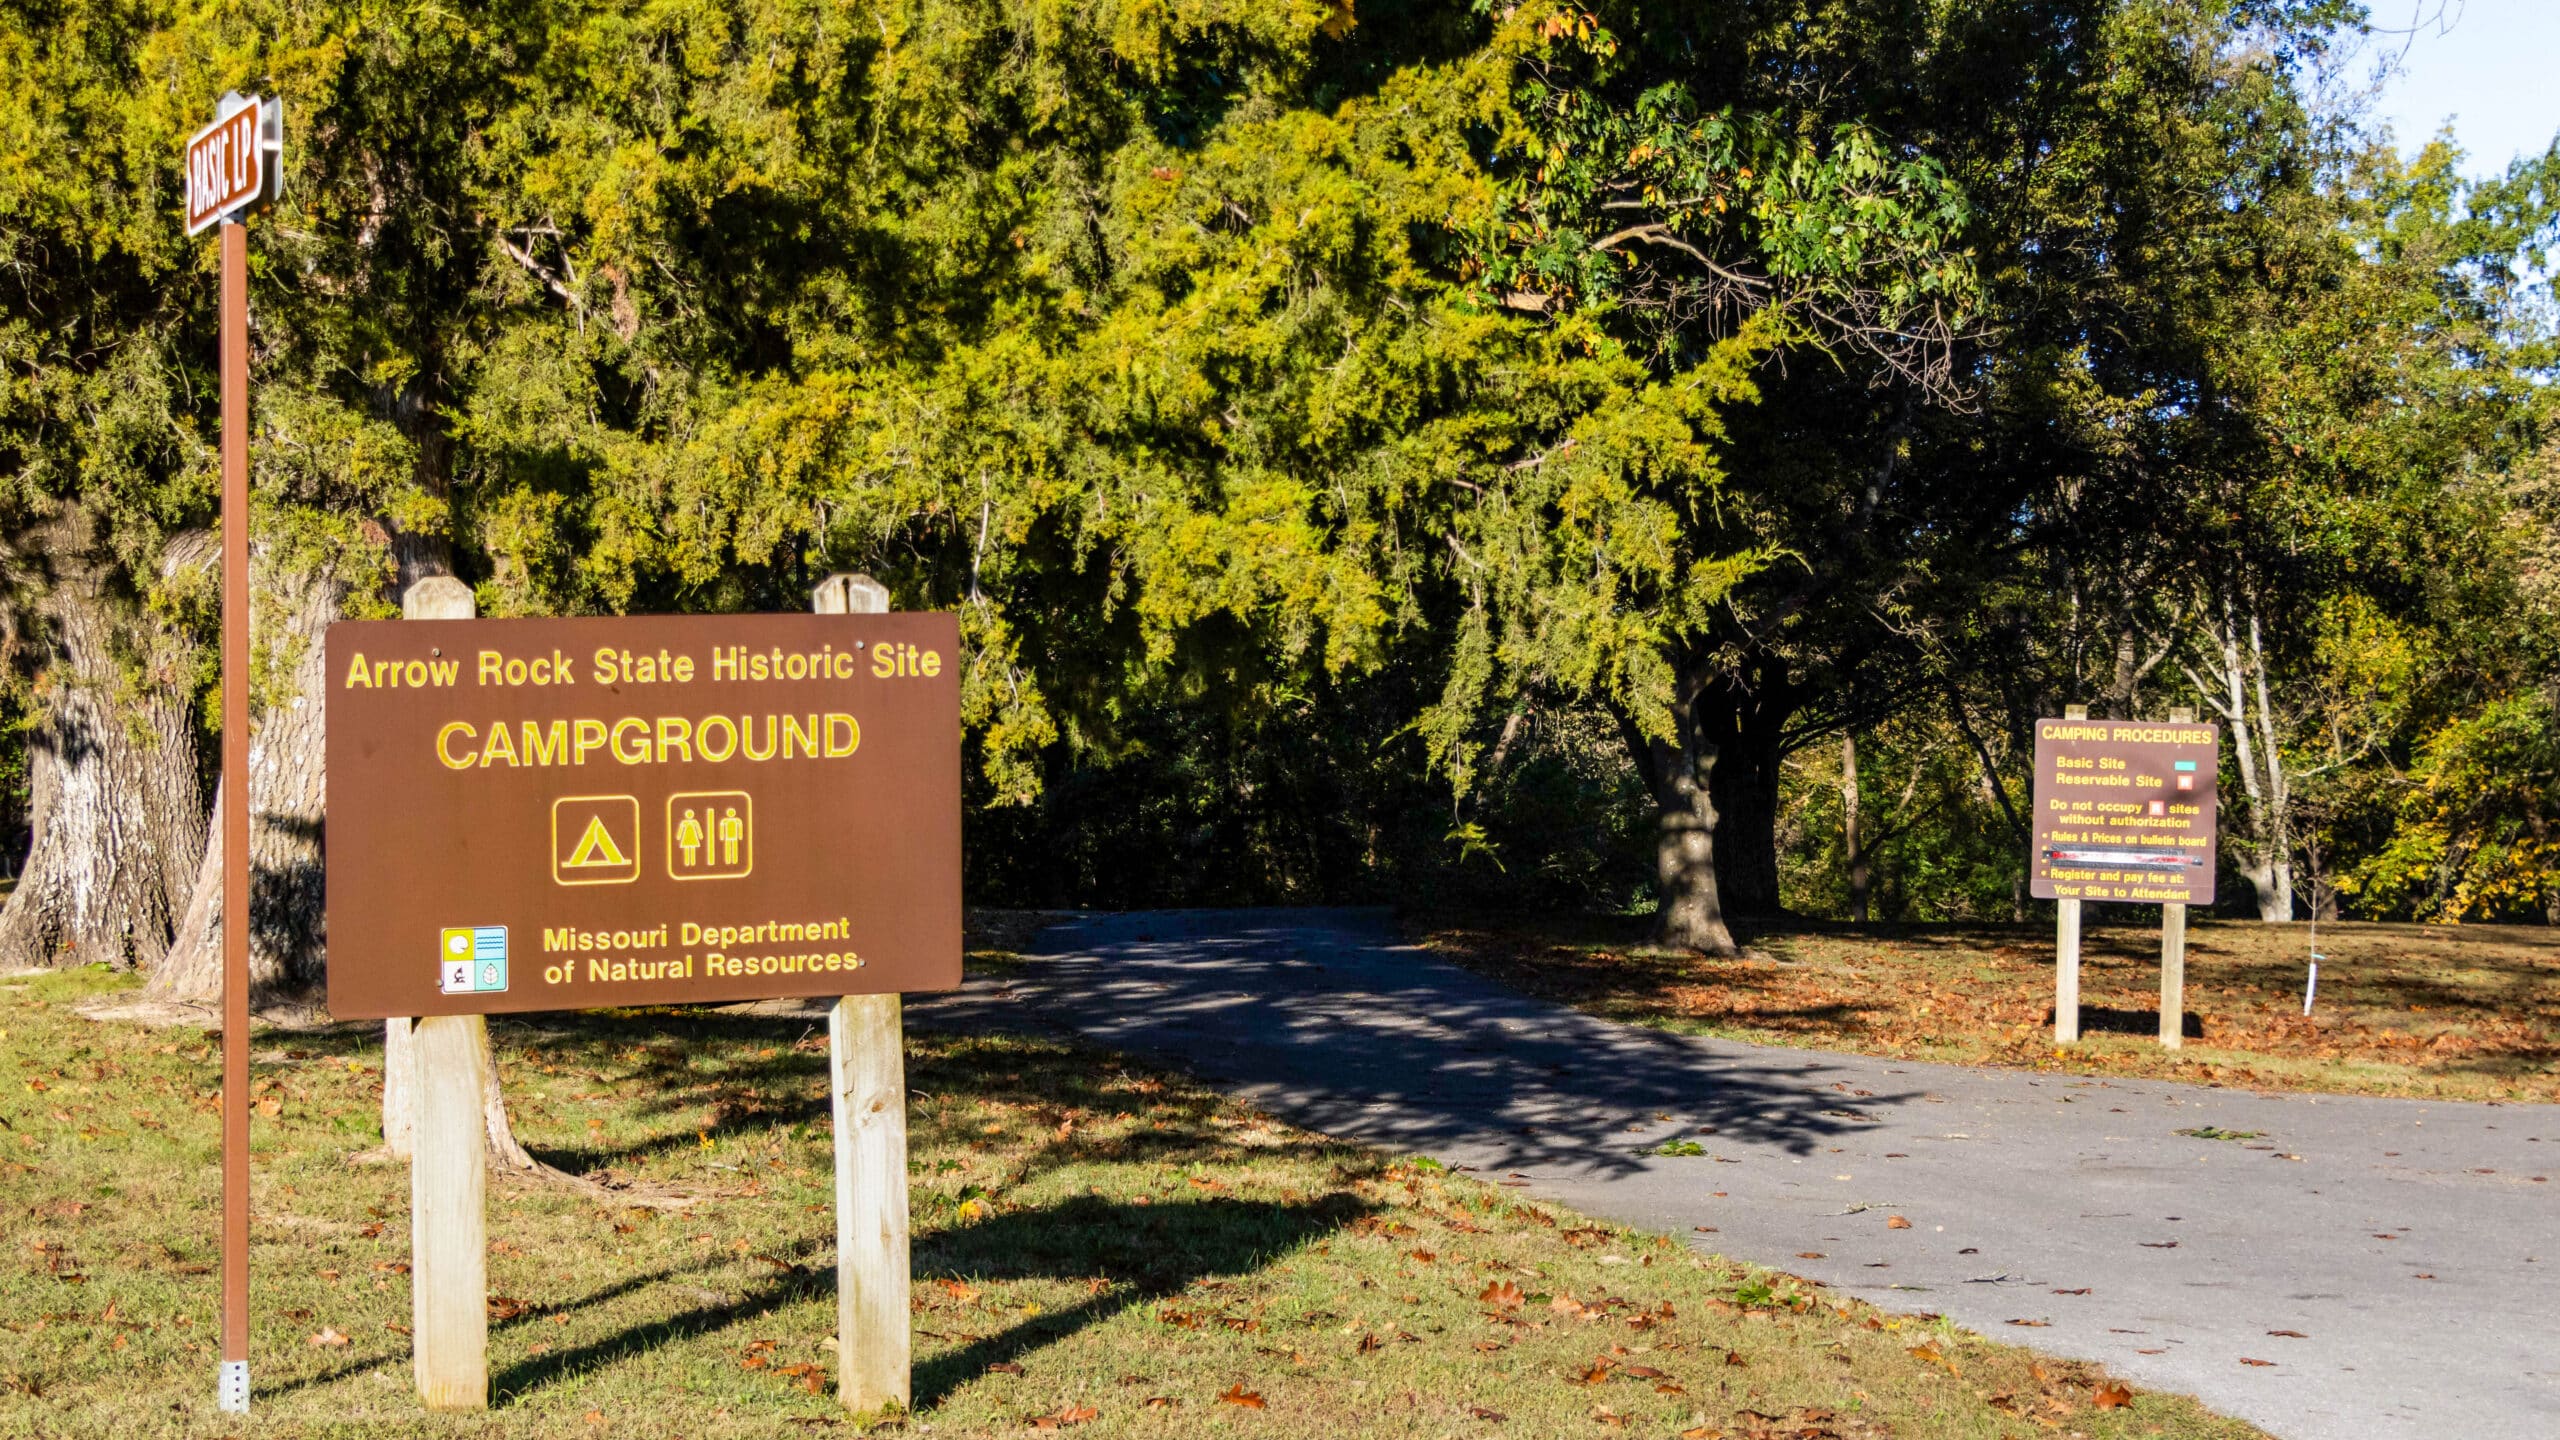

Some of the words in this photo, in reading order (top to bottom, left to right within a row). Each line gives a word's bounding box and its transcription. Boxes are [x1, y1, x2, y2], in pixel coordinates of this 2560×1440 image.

[193, 130, 230, 218] BASIC
[232, 115, 251, 193] LP
[346, 652, 459, 688] Arrow
[479, 650, 574, 685] Rock
[594, 648, 694, 684] State
[714, 645, 854, 681] Historic
[872, 643, 942, 678] Site
[436, 713, 861, 770] CAMPGROUND
[2042, 726, 2108, 742] CAMPING
[2113, 728, 2212, 744] PROCEDURES
[2056, 756, 2093, 769] Basic
[2099, 758, 2126, 770] Site
[2056, 773, 2130, 786] Reservable
[2136, 775, 2163, 787] Site
[2050, 799, 2067, 811] Do
[2072, 801, 2092, 811] not
[2097, 803, 2142, 815] occupy
[2169, 804, 2200, 815] sites
[2059, 814, 2105, 825] without
[2109, 816, 2191, 828] authorization
[2051, 831, 2077, 842] Rules
[2081, 833, 2089, 842] &
[2092, 833, 2121, 844] Prices
[2125, 835, 2137, 845] on
[2140, 834, 2175, 846] bulletin
[2178, 835, 2207, 847] board
[2050, 869, 2096, 882] Register
[2100, 871, 2120, 881] and
[2123, 872, 2144, 884] pay
[2148, 872, 2166, 883] fee
[2170, 873, 2184, 884] at:
[2054, 884, 2081, 896] Your
[2085, 885, 2109, 897] Site
[2114, 887, 2126, 898] to
[2130, 887, 2191, 900] Attendant
[544, 924, 668, 952] Missouri
[681, 917, 851, 949] Department
[544, 960, 575, 985] of
[589, 955, 692, 982] Natural
[707, 951, 858, 977] Resources
